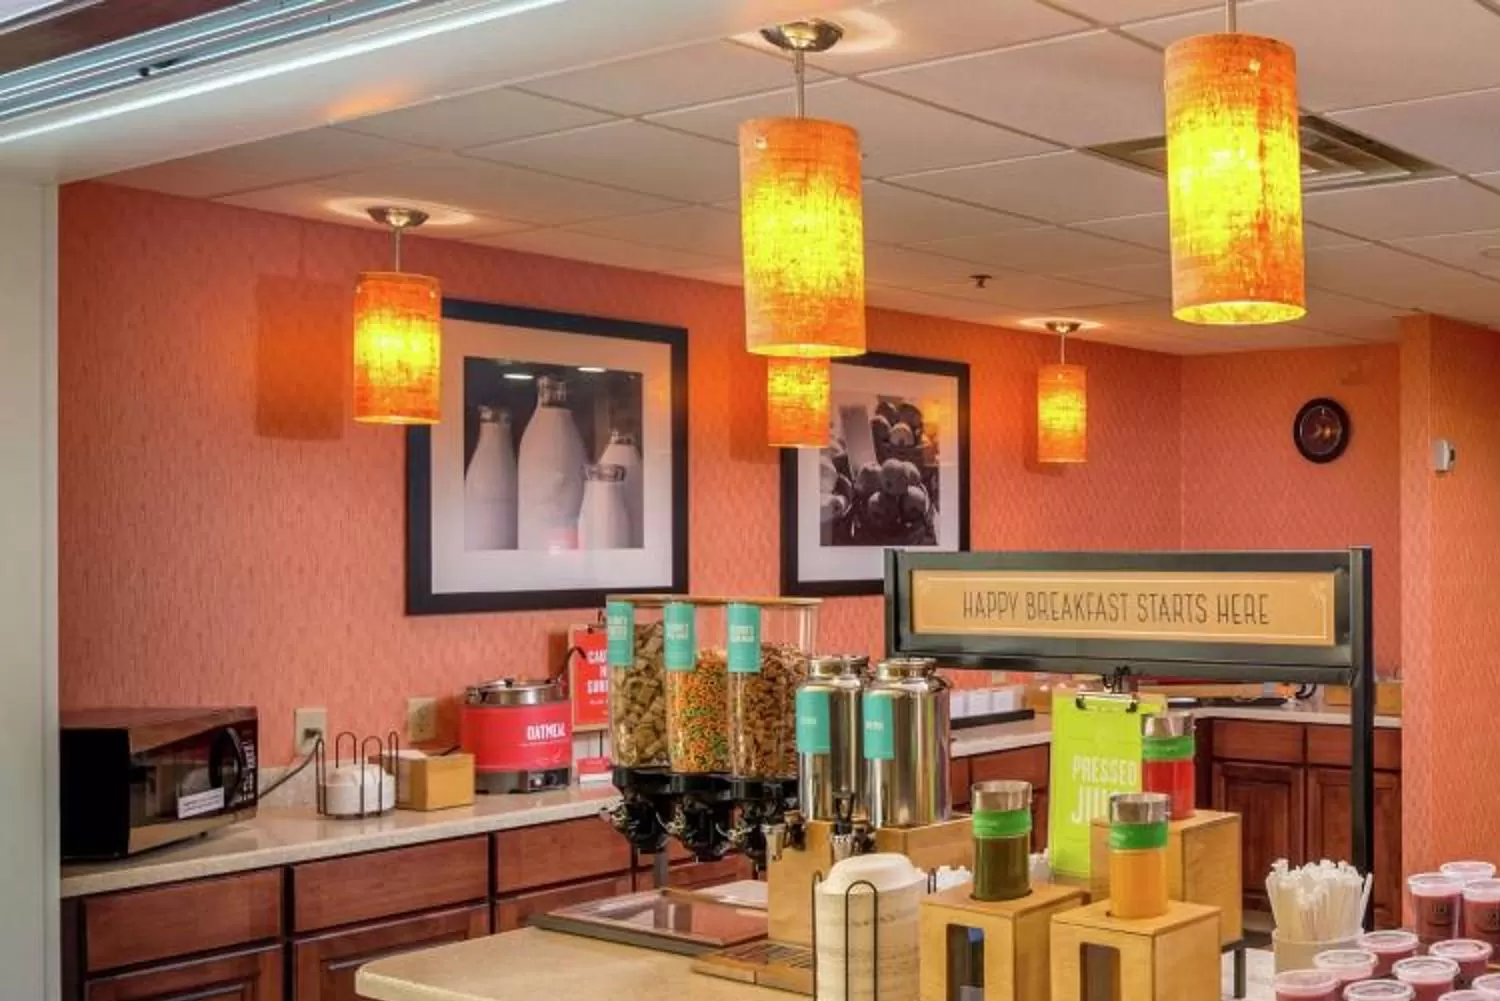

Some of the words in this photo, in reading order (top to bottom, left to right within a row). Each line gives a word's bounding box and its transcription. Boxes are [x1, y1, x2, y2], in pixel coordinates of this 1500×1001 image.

[963, 591, 1019, 620] HAPPY
[1025, 591, 1129, 622] BREAKFAST
[1137, 592, 1208, 625] STARTS
[1217, 593, 1270, 625] HERE
[527, 722, 566, 741] OATMEAL
[1072, 755, 1137, 786] PRESSED
[1071, 784, 1109, 825] JUI
